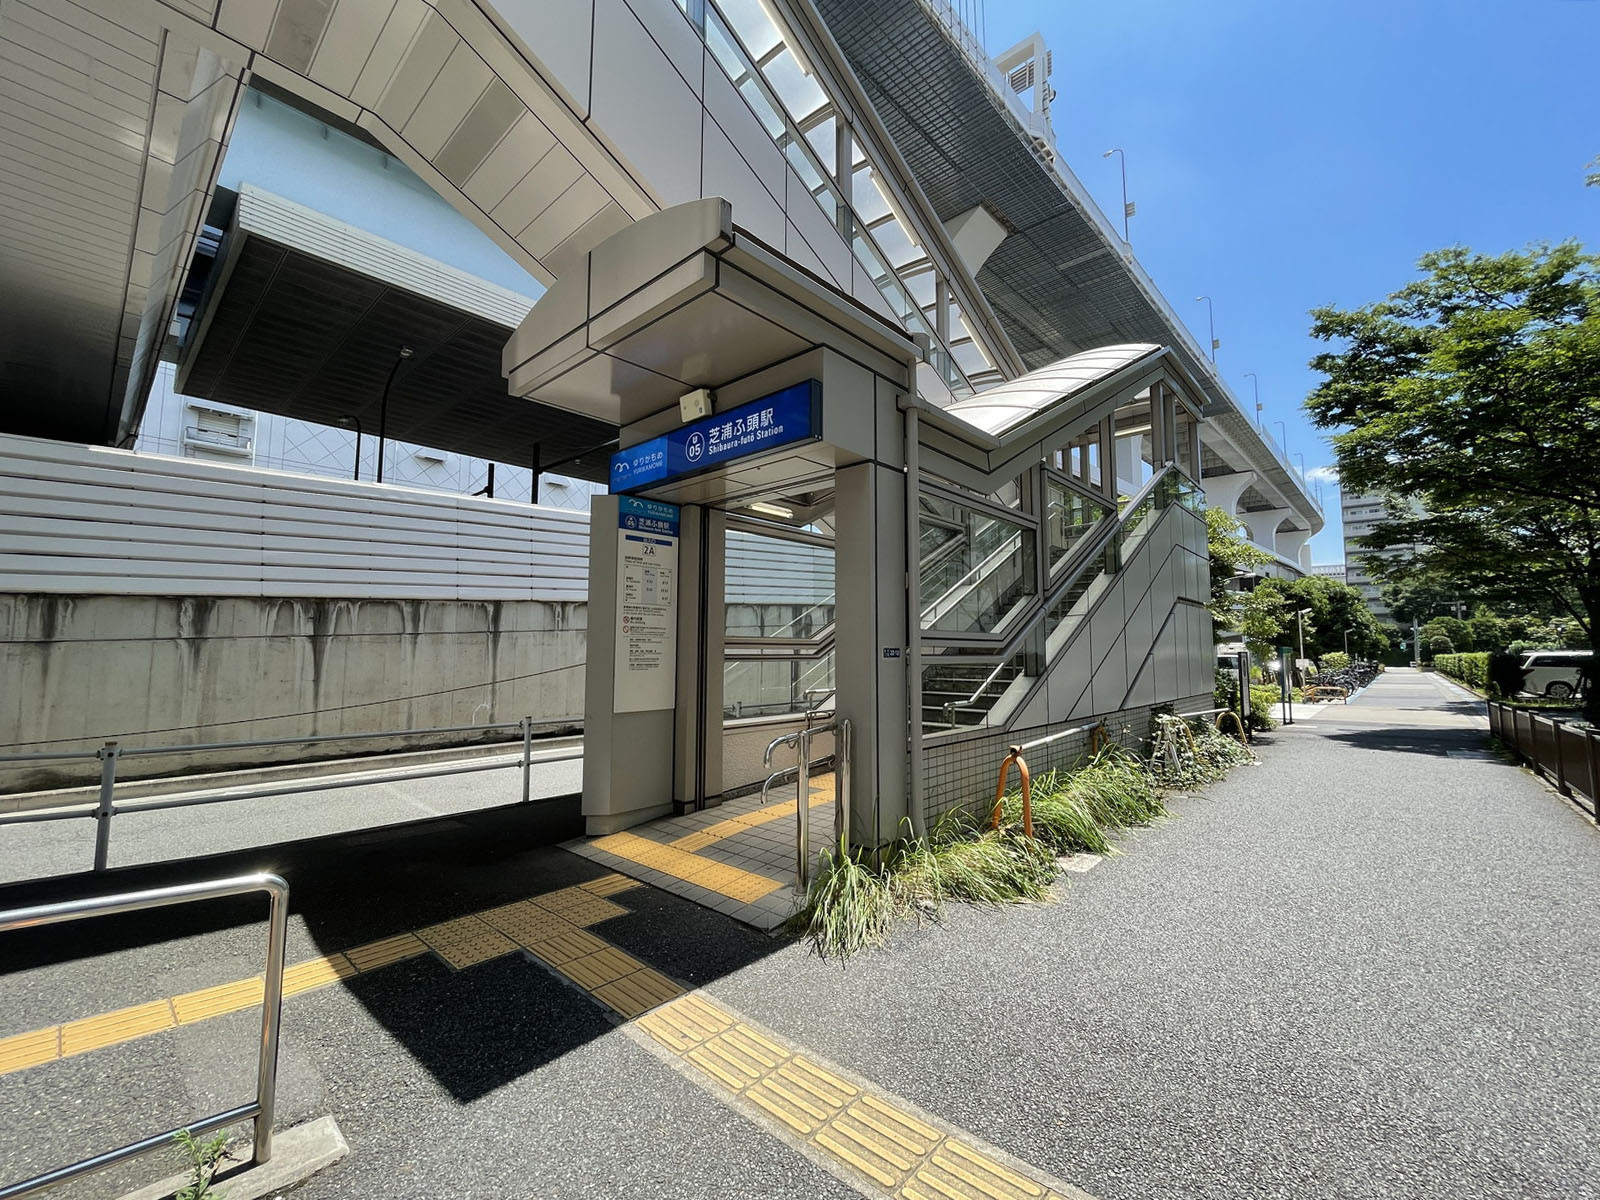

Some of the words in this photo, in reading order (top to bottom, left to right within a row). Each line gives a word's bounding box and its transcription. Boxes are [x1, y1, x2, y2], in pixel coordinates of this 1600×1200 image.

[708, 407, 773, 445] 芝浦ふ頭駅
[756, 425, 784, 440] Station
[692, 435, 698, 444] U
[689, 443, 701, 457] 05
[633, 451, 663, 467] ゆりかもめ
[643, 545, 655, 555] 2A
